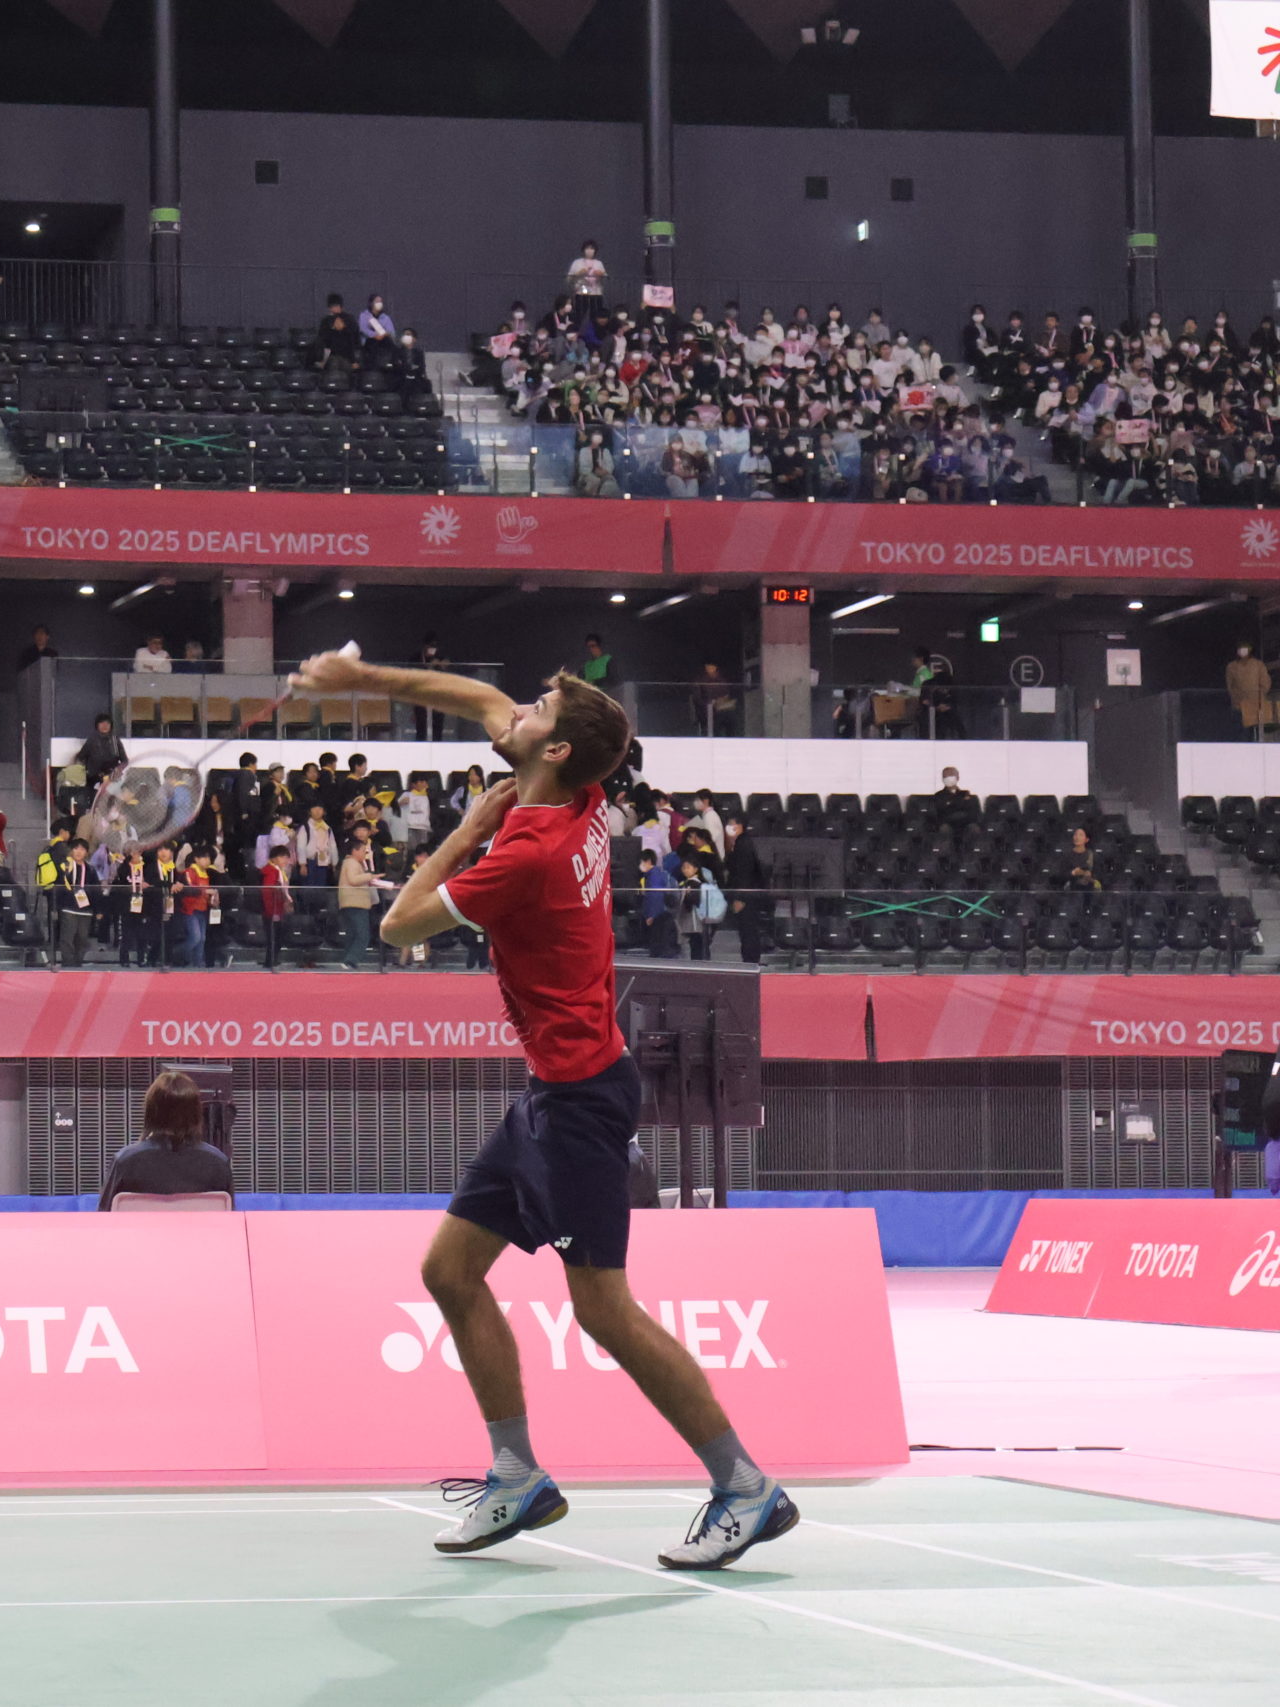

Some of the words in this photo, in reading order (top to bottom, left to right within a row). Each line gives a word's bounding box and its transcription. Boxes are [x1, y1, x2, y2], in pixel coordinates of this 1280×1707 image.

[21, 526, 109, 550] TOKYO
[119, 529, 179, 552] 2025
[188, 531, 370, 556] DEAFLYMPICS
[861, 542, 945, 565] TOKYO
[954, 543, 1013, 566] 2025
[1020, 545, 1194, 568] DEAFLYMPICS
[773, 589, 808, 602] 10:12
[141, 1020, 242, 1046] TOKYO
[252, 1020, 322, 1046] 2025
[331, 1021, 520, 1047] DEAFLYMPIC
[1090, 1021, 1186, 1045] TOKYO
[1196, 1021, 1264, 1045] 2025
[1044, 1240, 1094, 1274] YONEX
[1124, 1242, 1200, 1278] TOYOTA
